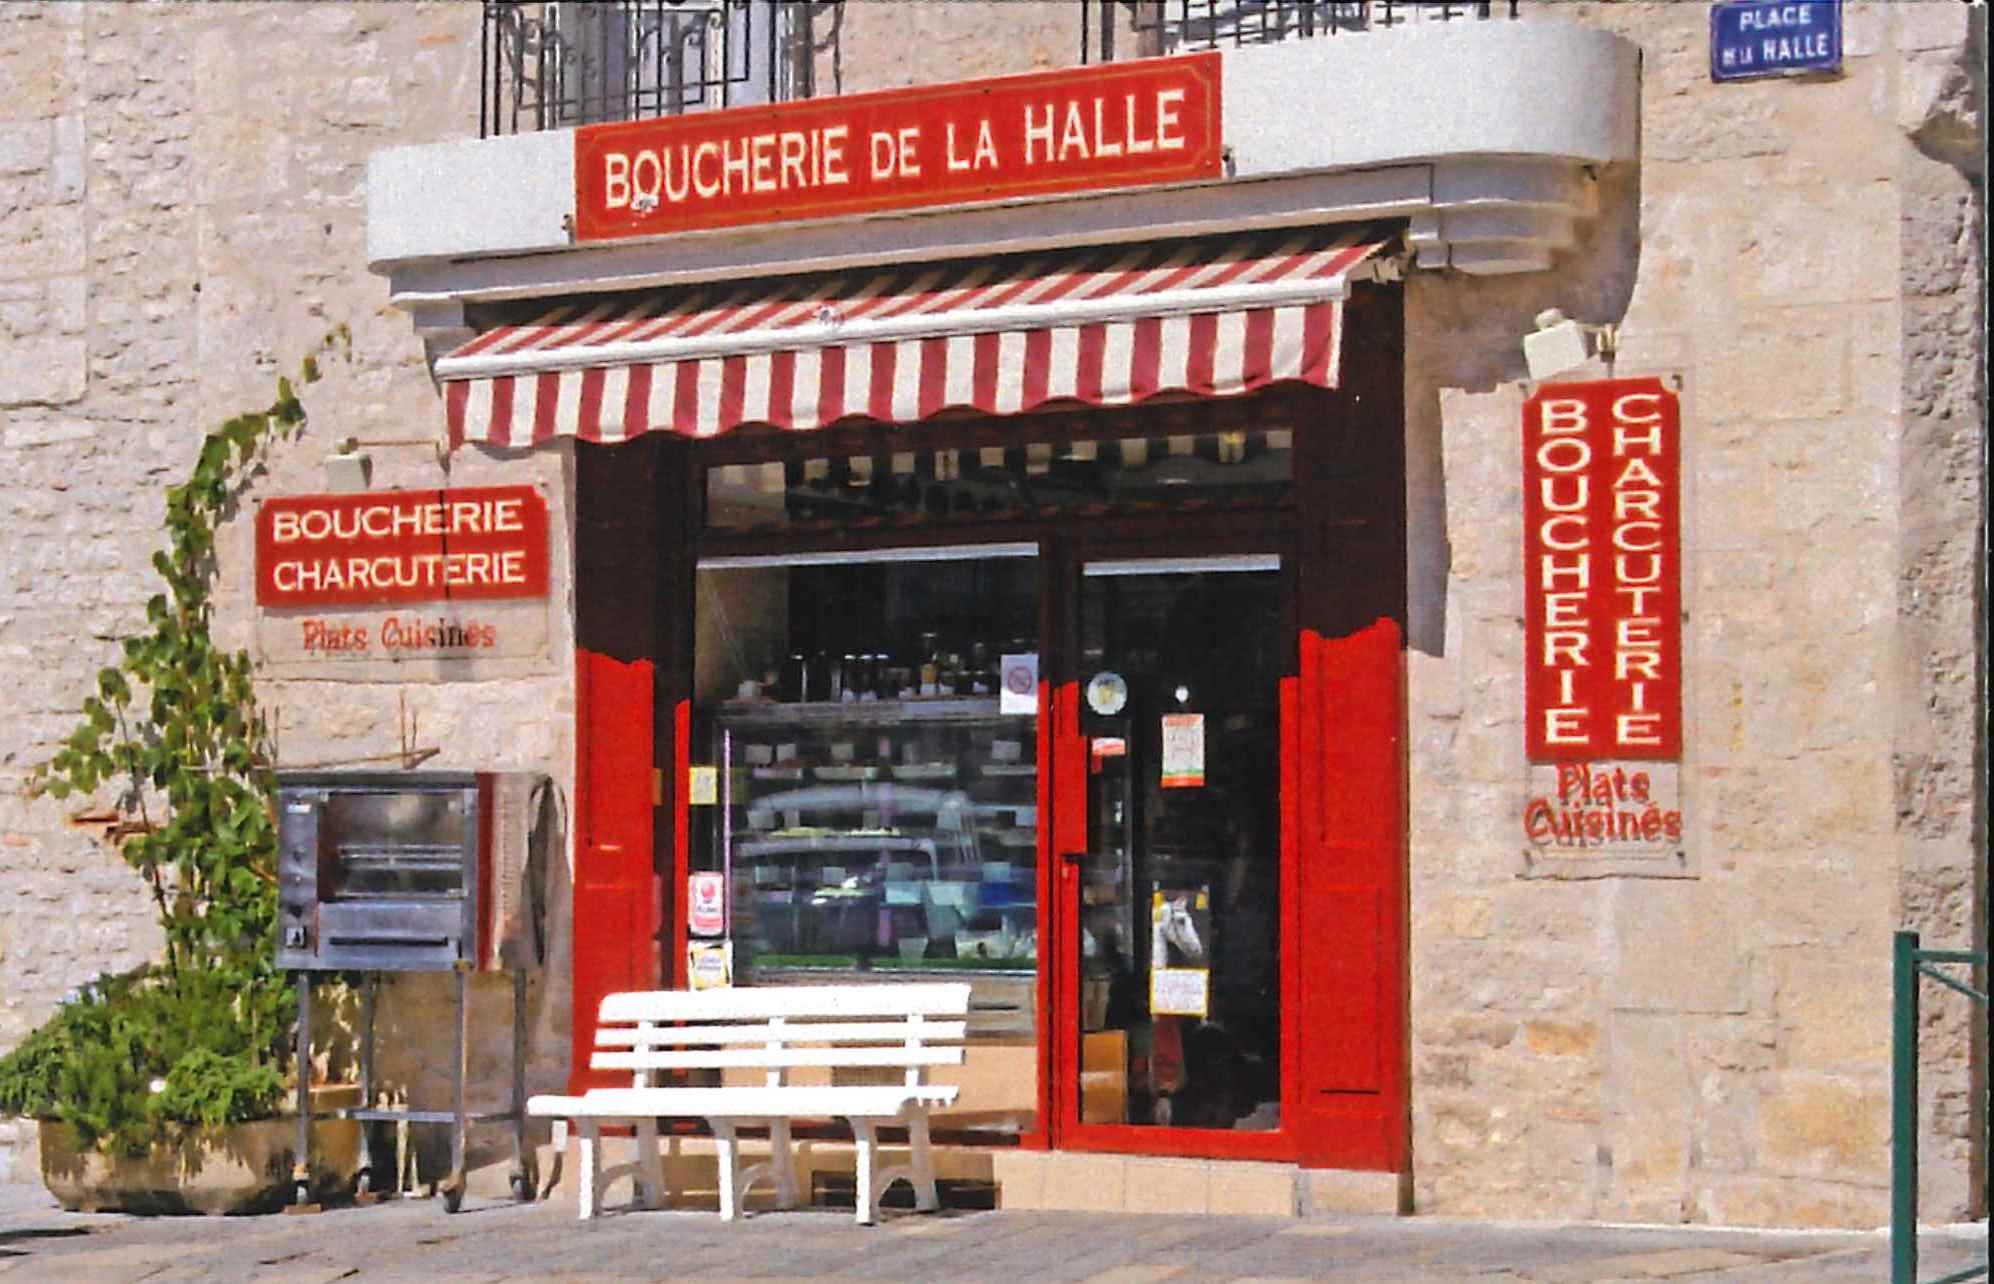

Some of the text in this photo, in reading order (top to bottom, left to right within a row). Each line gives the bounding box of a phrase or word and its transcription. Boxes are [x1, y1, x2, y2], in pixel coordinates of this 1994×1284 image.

[1739, 4, 1812, 31] PLACE
[1762, 33, 1829, 61] HALLE
[605, 88, 1185, 209] BOUCHERIE DE LA HALLE
[272, 499, 523, 543] BOUCHERIE
[273, 550, 526, 592] CHARCUTERIE
[1536, 398, 1591, 744] BOUCHERIE
[1611, 393, 1663, 744] CHARCUTERIE
[303, 617, 368, 651] Plats
[1555, 762, 1650, 802] Plats
[1523, 797, 1682, 841] Cuisinés
